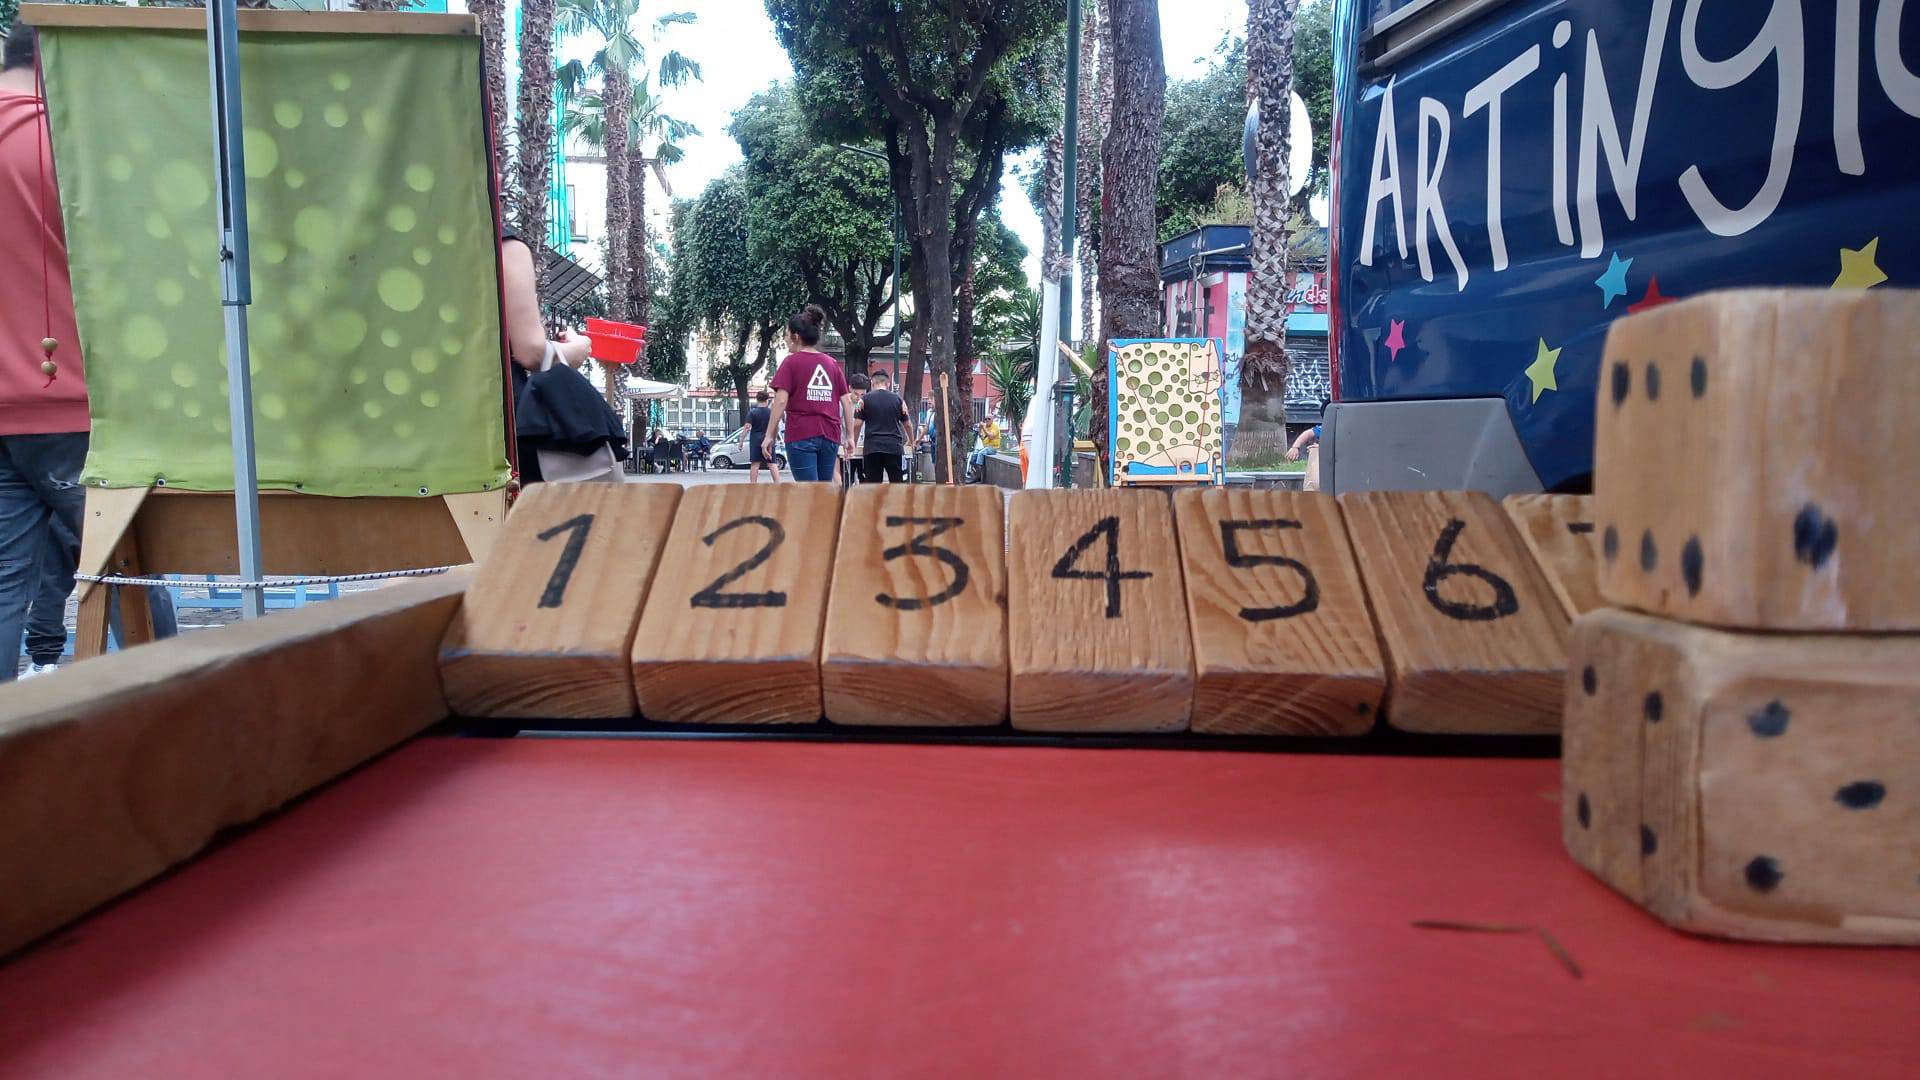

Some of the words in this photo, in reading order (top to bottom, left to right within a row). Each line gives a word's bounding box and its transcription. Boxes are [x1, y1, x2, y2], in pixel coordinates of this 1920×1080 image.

[537, 513, 595, 609] 1
[690, 514, 787, 609] 2
[874, 516, 970, 611] 3
[1051, 515, 1154, 619] 4
[1218, 518, 1321, 622] 5
[1421, 518, 1521, 623] 6
